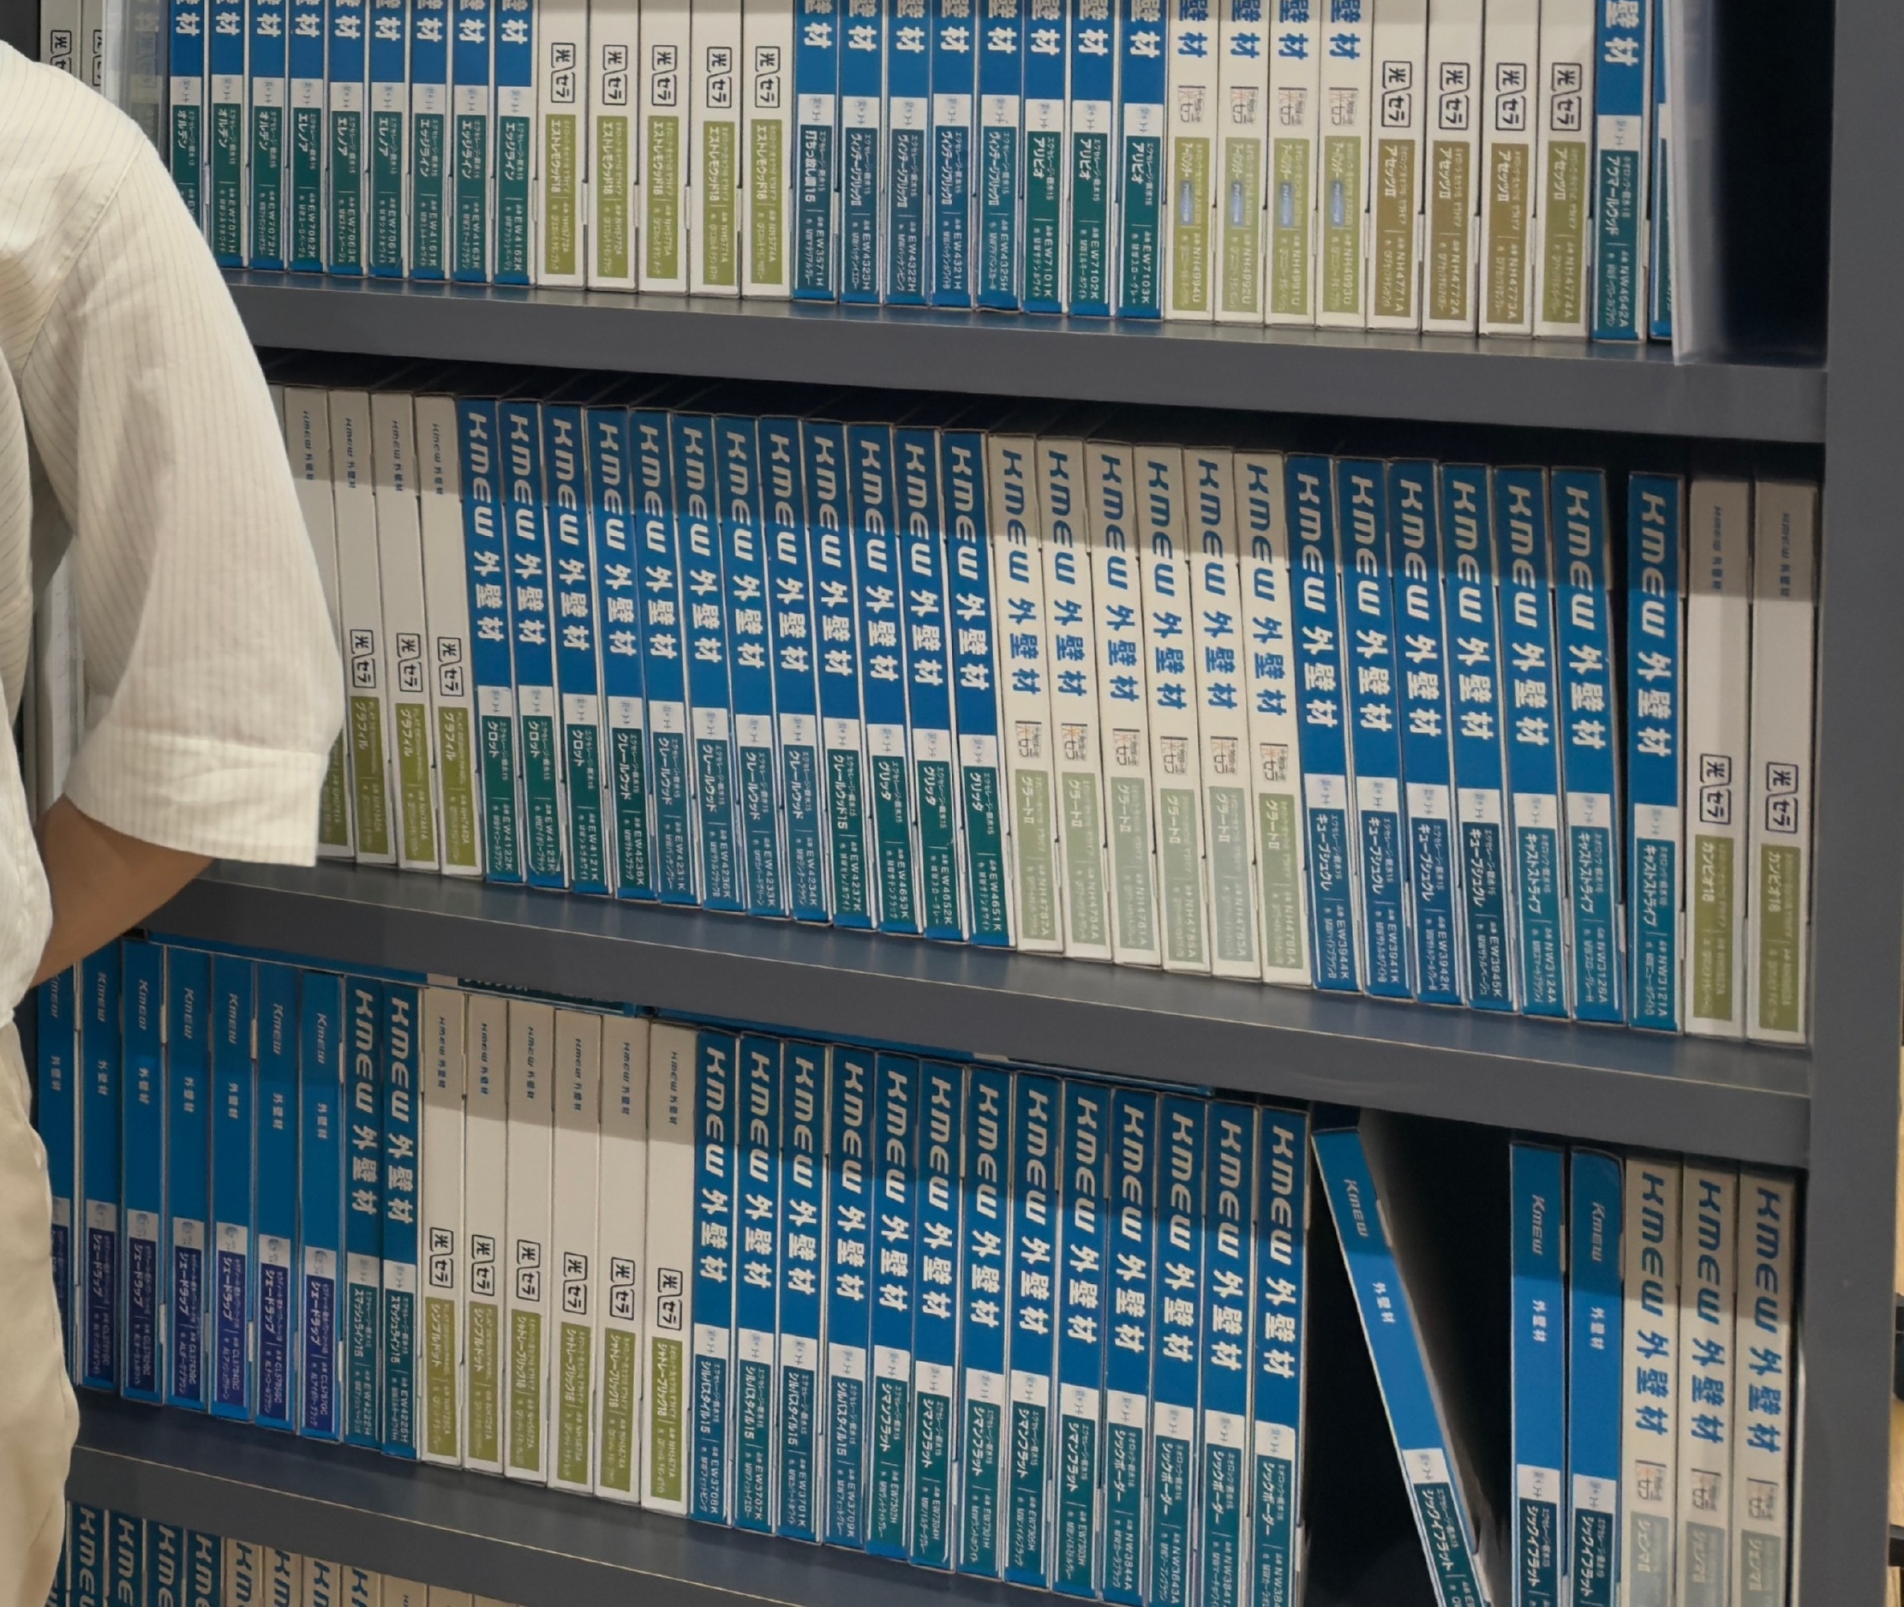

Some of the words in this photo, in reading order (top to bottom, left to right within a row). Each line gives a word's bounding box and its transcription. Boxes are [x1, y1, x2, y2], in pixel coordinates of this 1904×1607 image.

[475, 551, 504, 643] 外壁材
[955, 593, 991, 690] 外壁材
[1636, 651, 1672, 758] 外壁材
[351, 1124, 379, 1217] 外壁材
[837, 1203, 866, 1301] 外壁材
[1264, 1276, 1296, 1378] 外壁材
[1372, 1281, 1396, 1324] 外壁材
[1748, 1346, 1781, 1454] 外壁材
